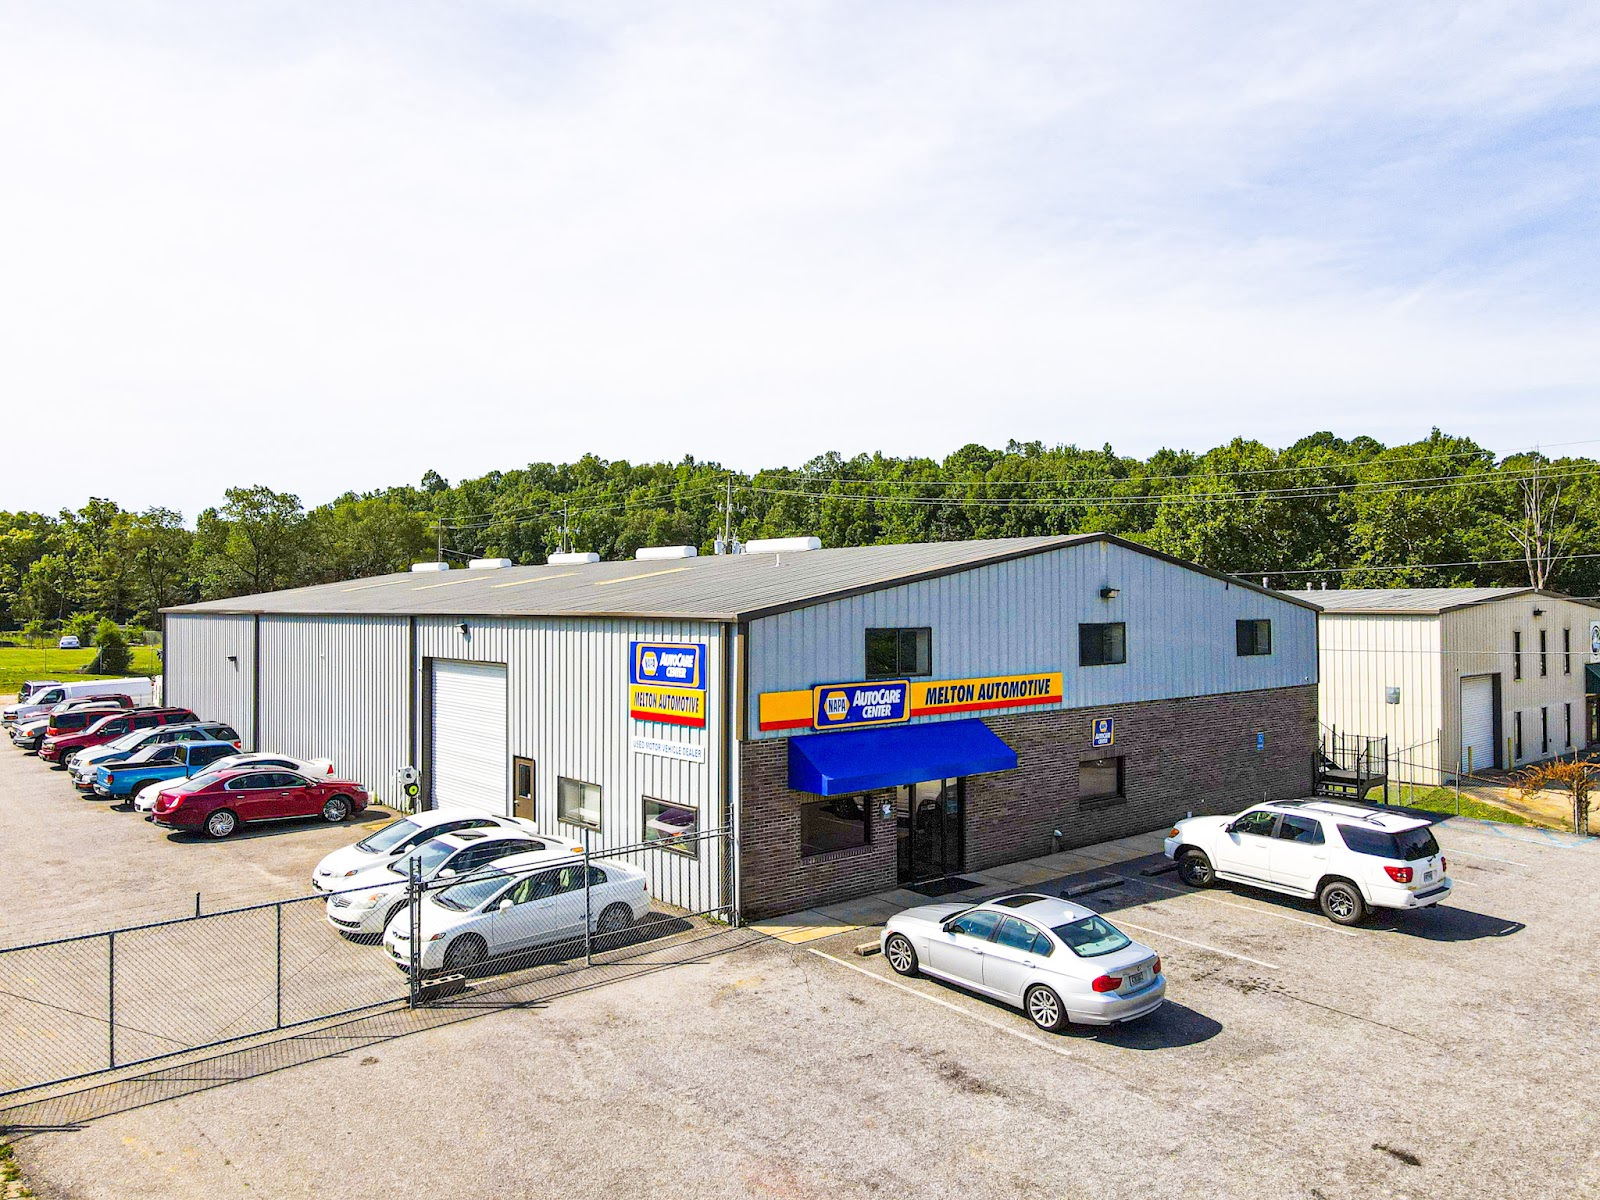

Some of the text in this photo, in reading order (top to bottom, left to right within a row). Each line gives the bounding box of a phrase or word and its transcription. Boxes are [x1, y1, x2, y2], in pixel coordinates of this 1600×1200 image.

[666, 667, 687, 678] CENTER
[852, 688, 902, 706] AUTOCARE
[925, 678, 1051, 706] MELTON AUTOMOTIVE
[634, 692, 699, 713] MELTON AUTOMOTIVE
[828, 698, 846, 712] NAPA
[862, 704, 892, 719] CENTER
[633, 740, 702, 758] USED MOTOR VEHICLE DEALER
